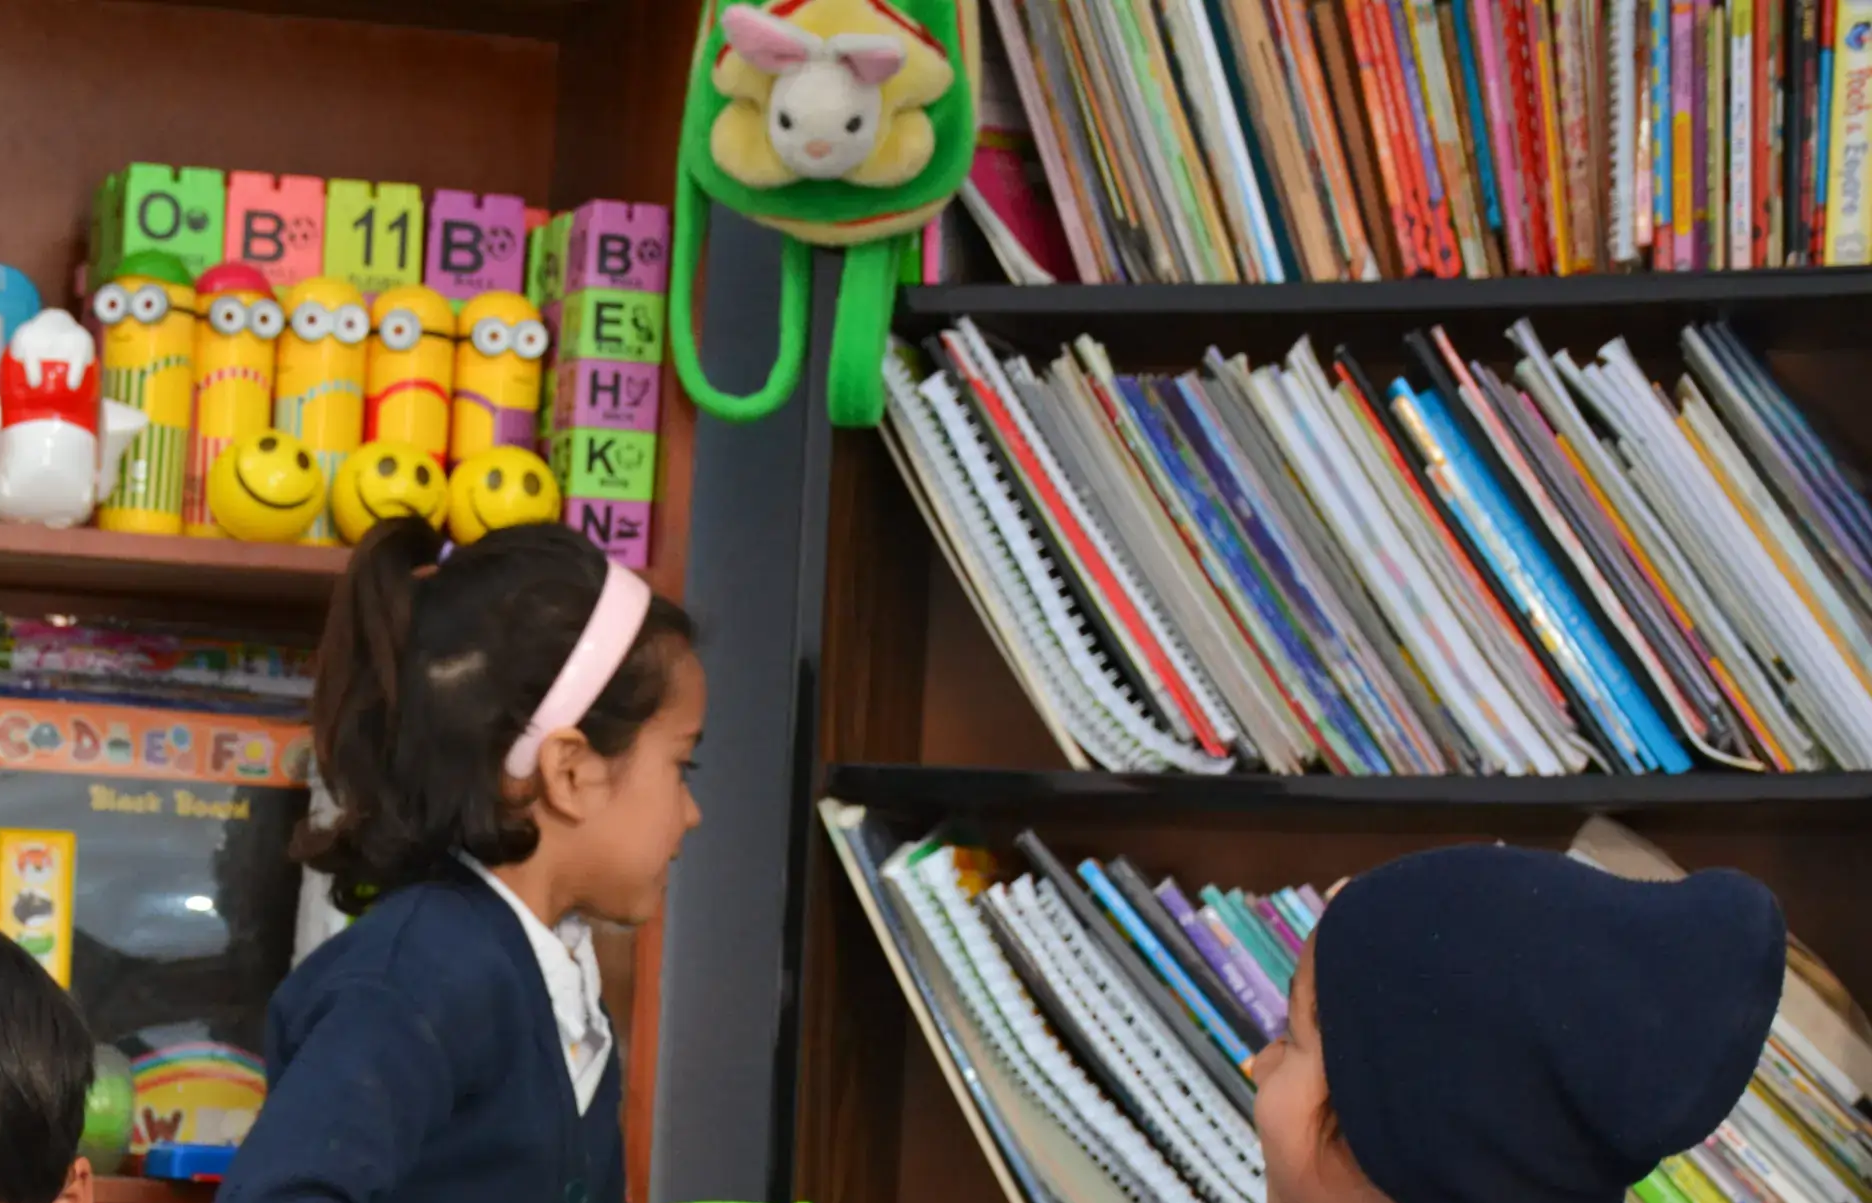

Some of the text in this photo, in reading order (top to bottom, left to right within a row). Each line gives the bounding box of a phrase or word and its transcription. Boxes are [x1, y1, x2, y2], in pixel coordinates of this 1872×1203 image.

[138, 190, 182, 241] O
[242, 209, 286, 263] B
[352, 206, 409, 270] 11
[439, 218, 485, 275] B
[597, 233, 632, 276] B
[594, 300, 625, 343] E
[589, 369, 622, 408] H
[586, 436, 616, 477] K
[582, 502, 613, 543] N
